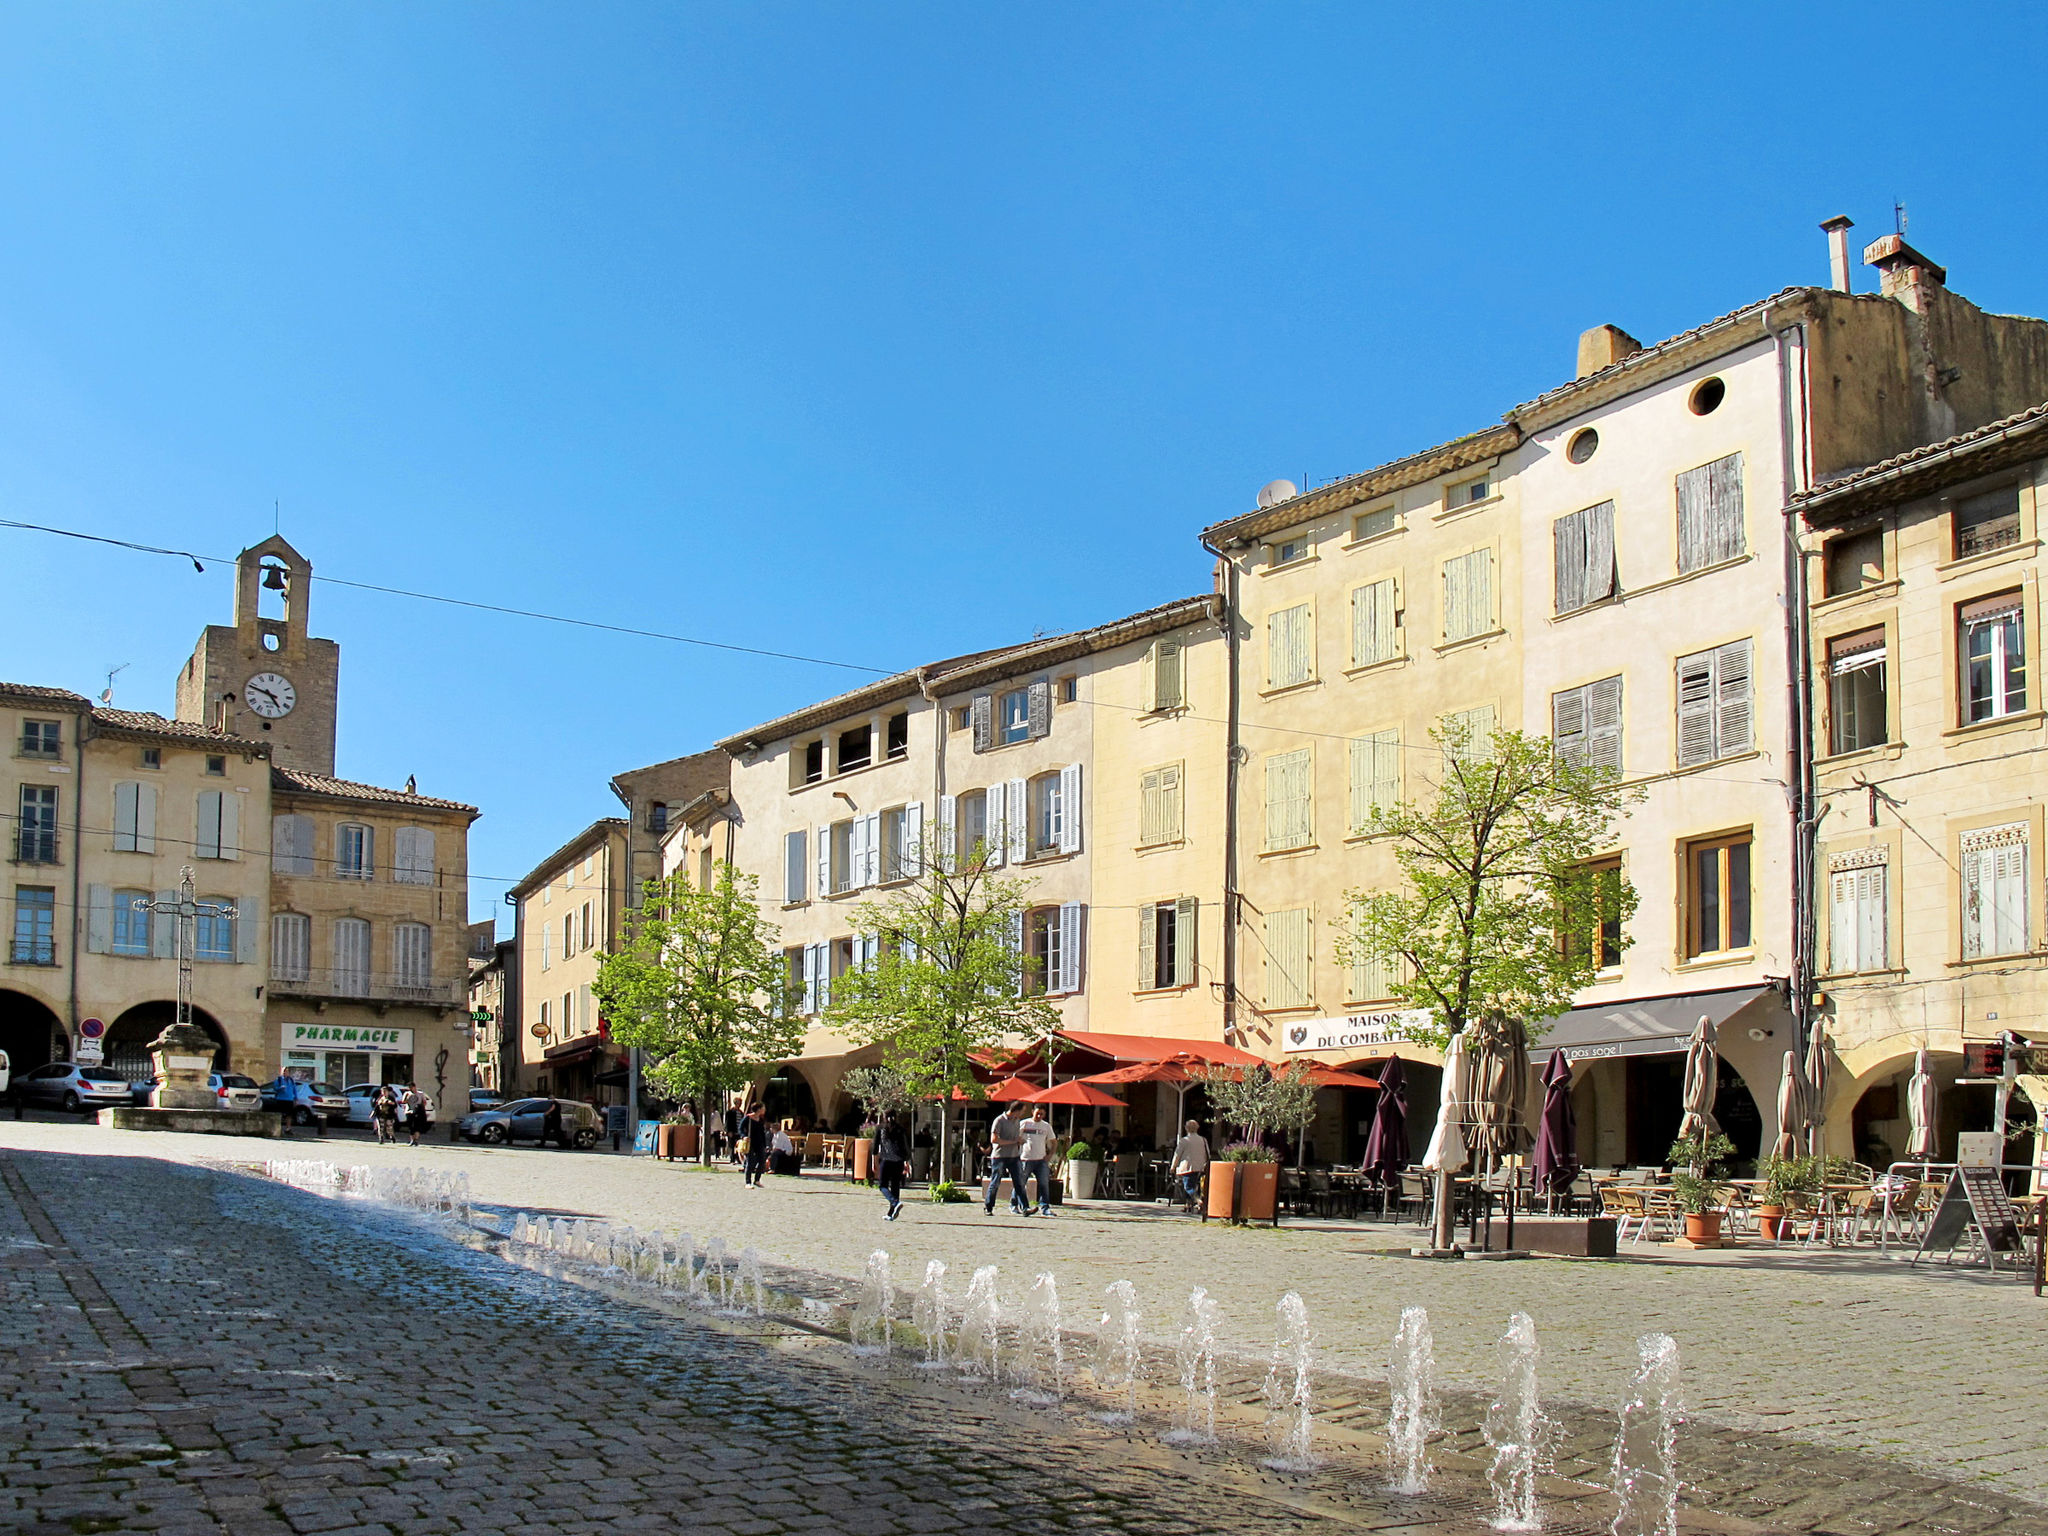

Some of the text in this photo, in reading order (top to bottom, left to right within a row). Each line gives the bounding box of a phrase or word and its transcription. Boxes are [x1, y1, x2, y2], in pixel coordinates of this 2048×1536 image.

[1348, 1012, 1400, 1028] MAISON
[295, 1026, 400, 1043] PHARMACIE
[1318, 1036, 1336, 1048] DU
[1571, 1049, 1589, 1059] pas
[1592, 1046, 1616, 1057] sage
